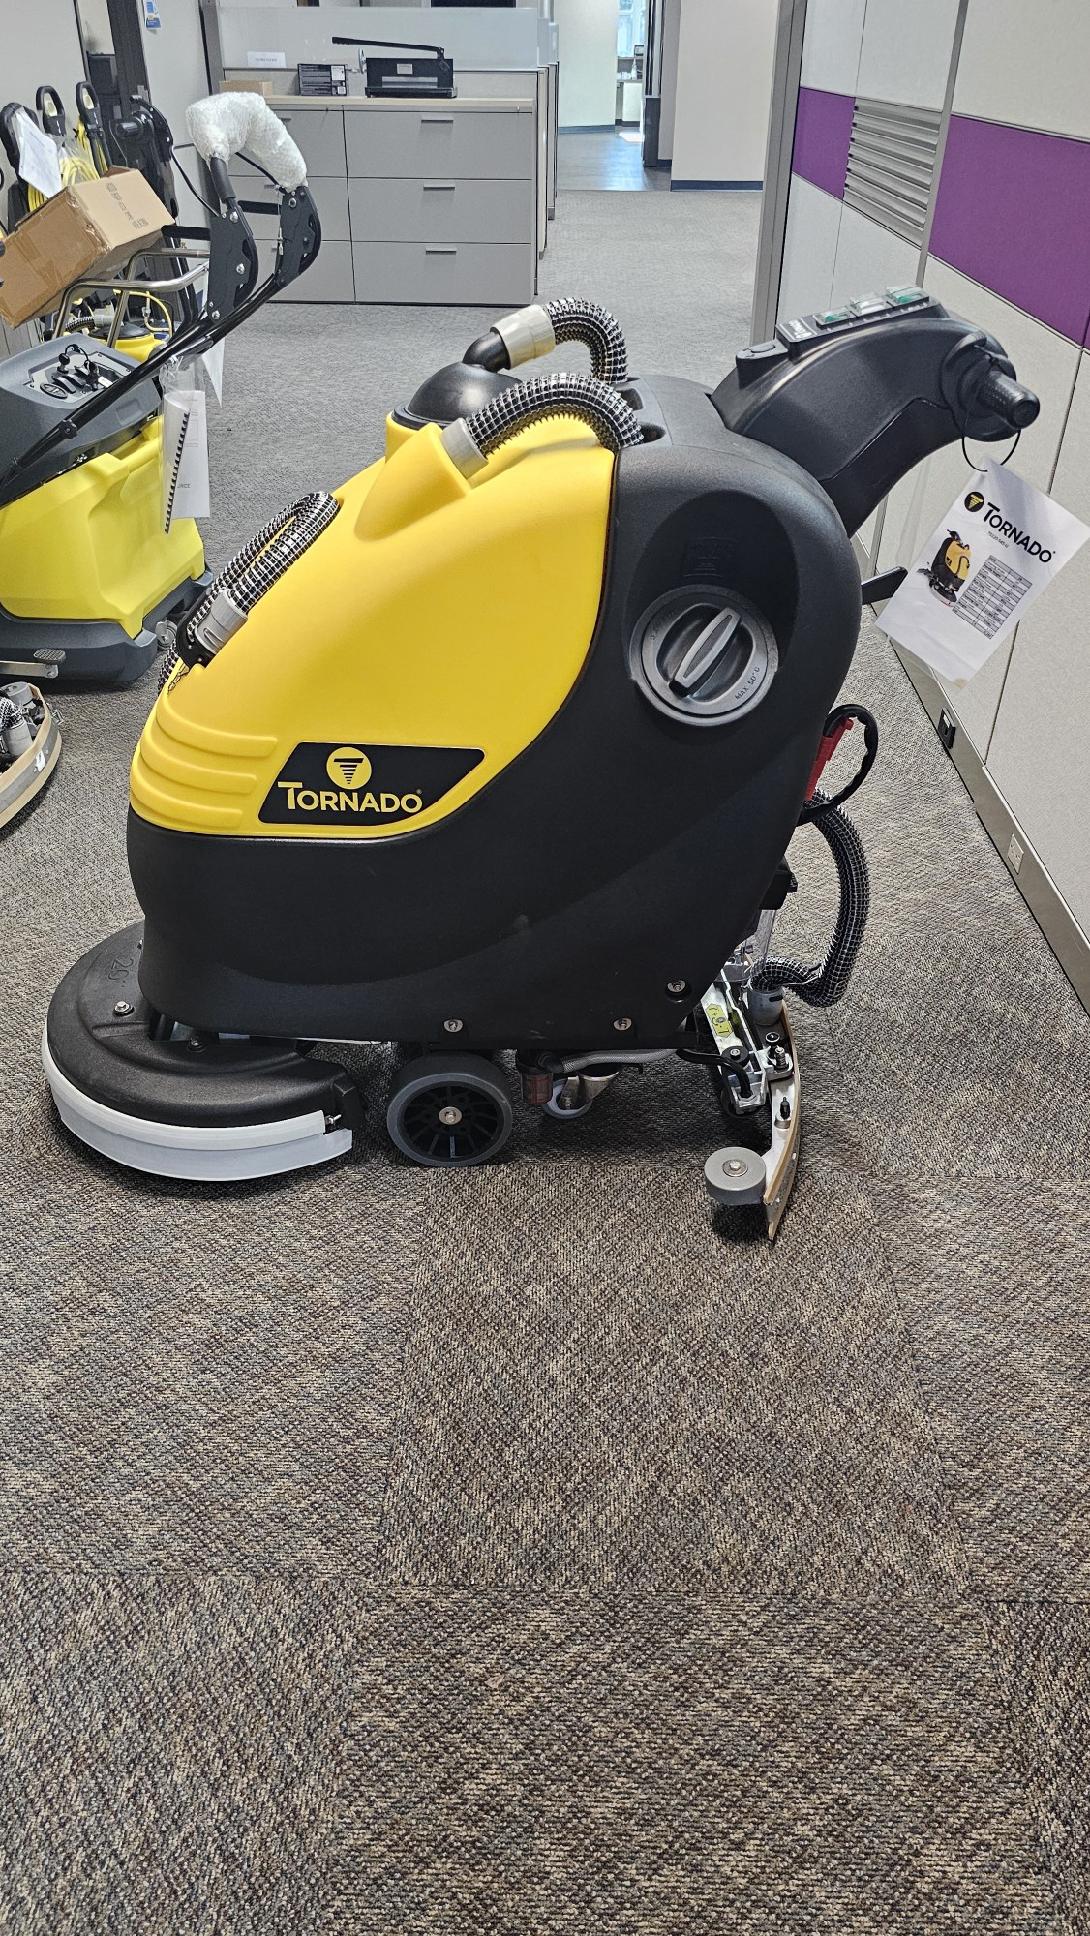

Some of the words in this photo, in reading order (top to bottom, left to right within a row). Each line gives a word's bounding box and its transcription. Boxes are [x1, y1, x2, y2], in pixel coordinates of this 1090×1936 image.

[983, 502, 1052, 563] TORNADO
[735, 685, 750, 700] MAX
[277, 780, 423, 813] TORNADO
